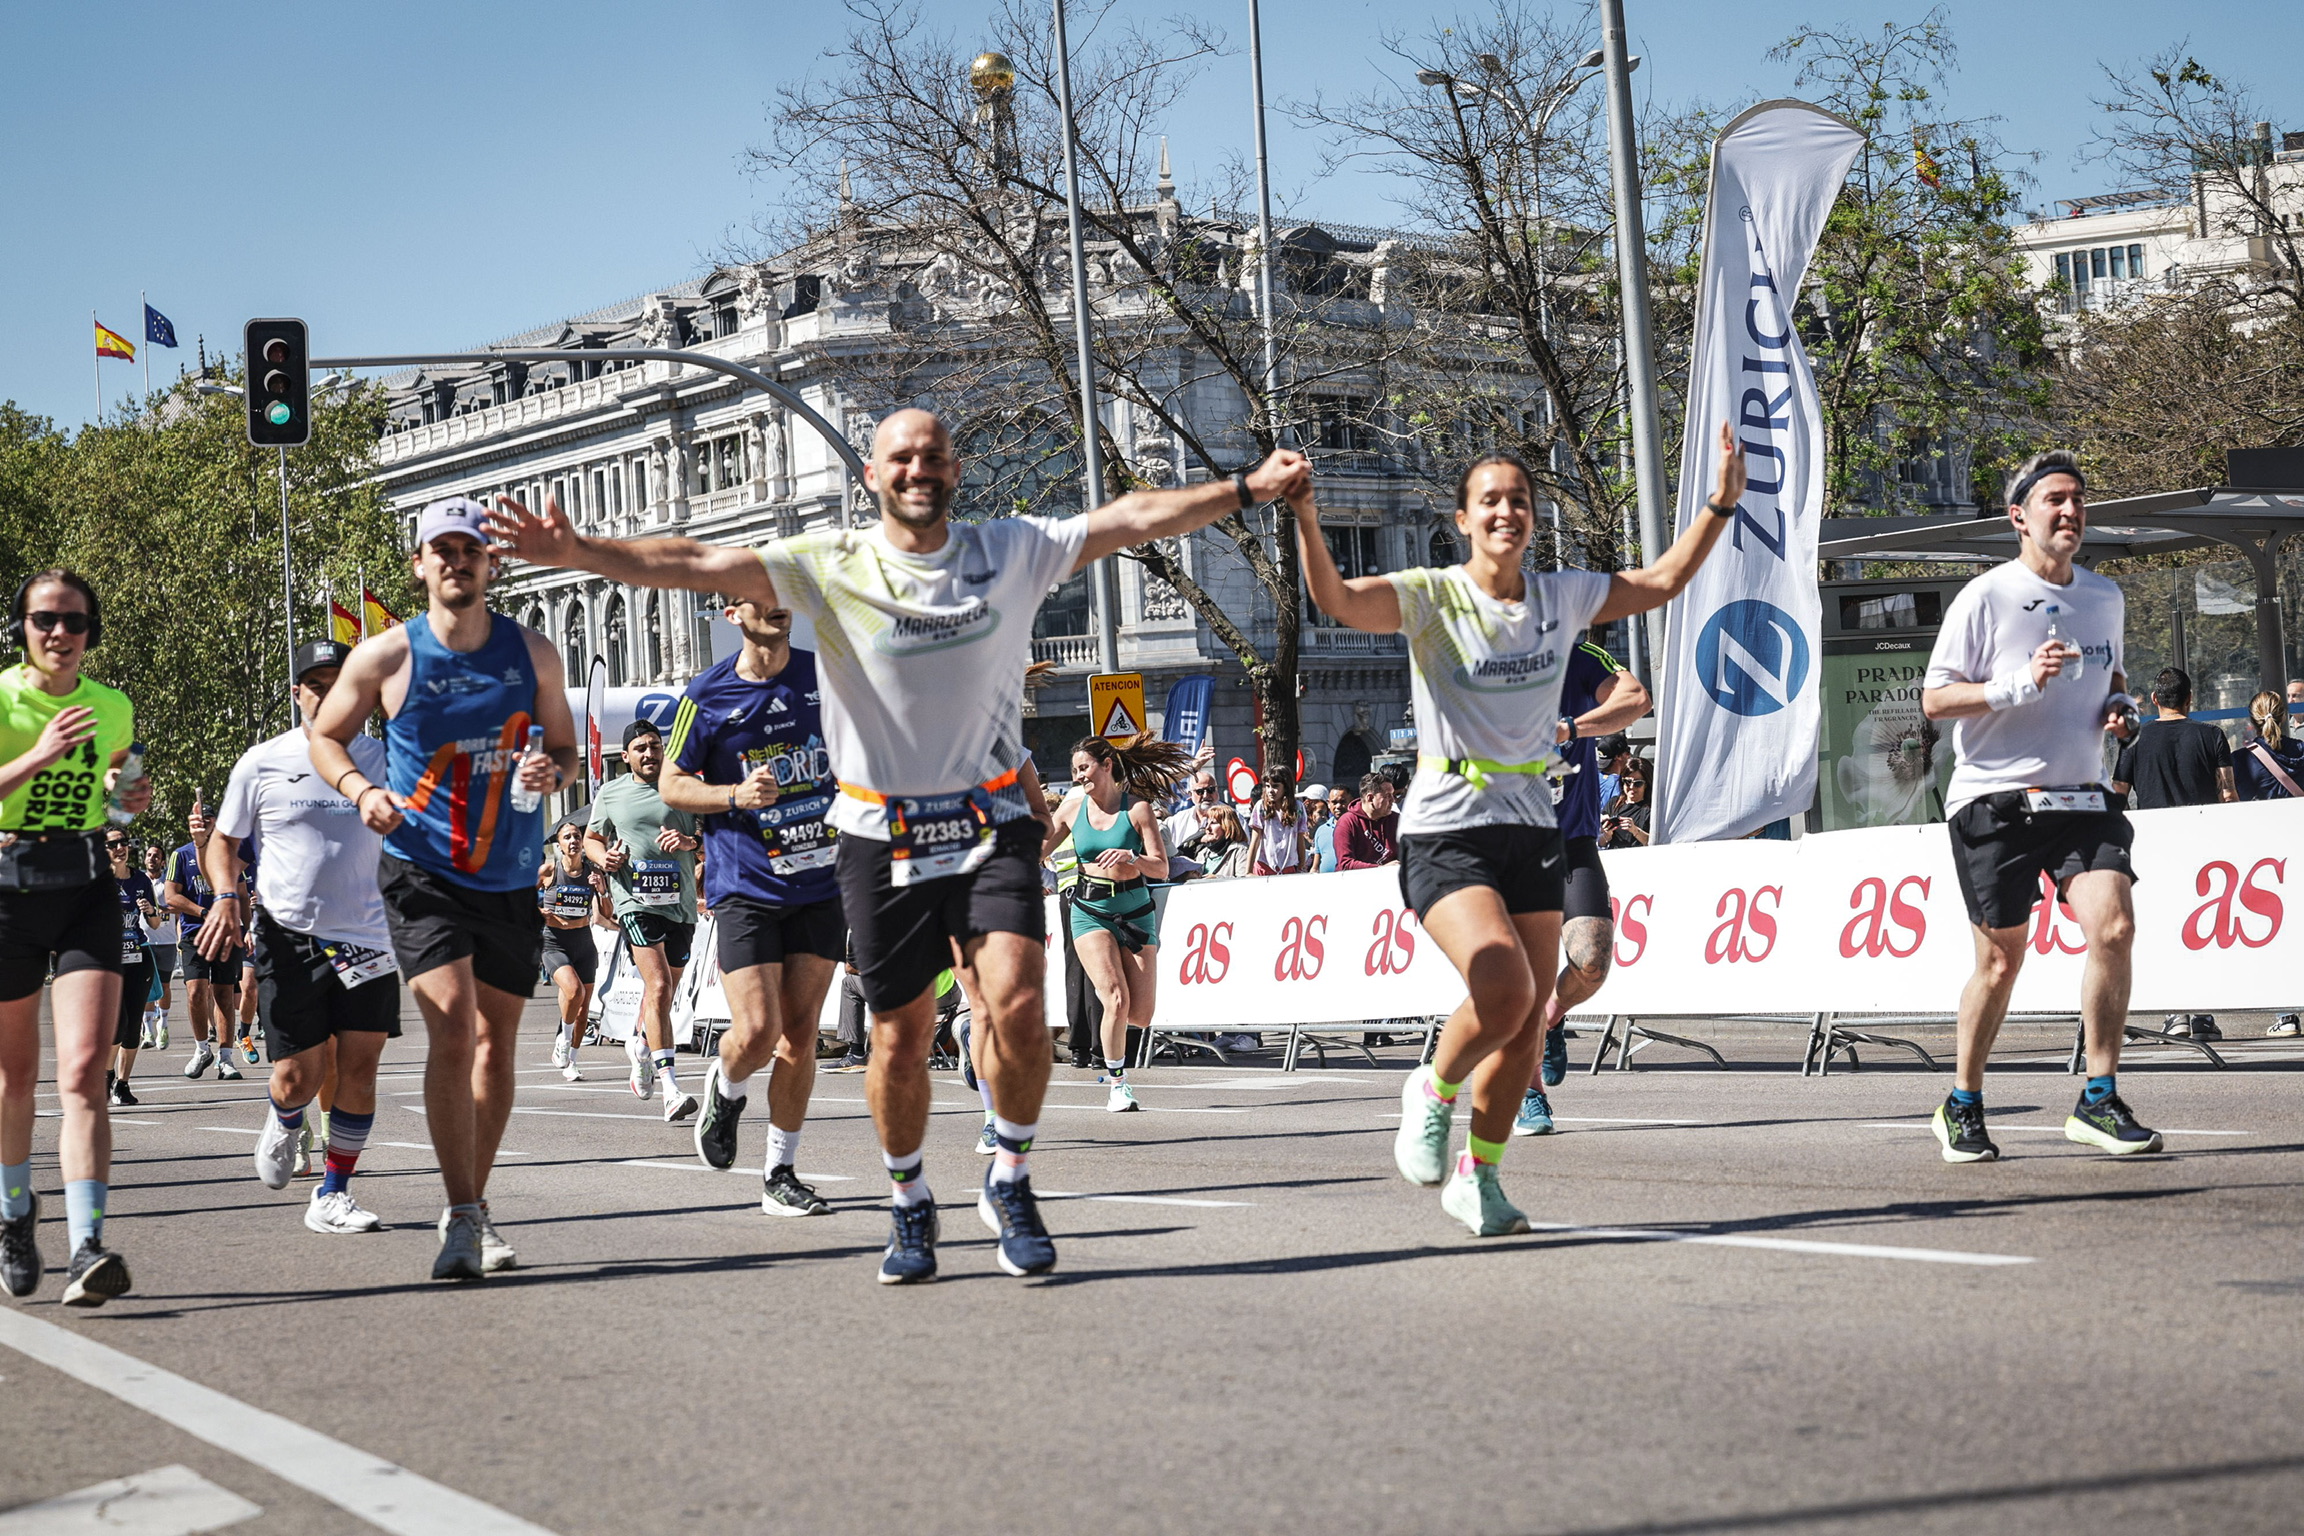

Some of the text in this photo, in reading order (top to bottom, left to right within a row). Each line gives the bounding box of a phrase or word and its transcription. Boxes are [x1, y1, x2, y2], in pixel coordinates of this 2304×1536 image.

[316, 646, 334, 656] MIA
[1875, 642, 1911, 651] JCDecaux
[1472, 649, 1555, 677] MARAZUELA
[1857, 665, 1926, 684] PRADA
[1094, 680, 1140, 692] ATENCION
[1845, 687, 1925, 705] PARADO
[774, 721, 795, 731] ZURICH
[1874, 715, 1918, 723] FRAGRANCES
[748, 743, 785, 762] SIENTE
[472, 750, 514, 776] FAST
[48, 771, 74, 816] CON
[290, 800, 339, 809] HYUNDAI
[785, 801, 820, 817] ZURICH
[924, 797, 964, 813] ZURIC
[779, 821, 824, 846] 34492
[912, 818, 975, 845] 22383
[641, 875, 669, 887] 21831
[563, 895, 584, 904] 34292
[1179, 921, 1234, 986] as
[1274, 914, 1328, 982] as
[1364, 908, 1419, 977] as
[1704, 885, 1783, 965] as
[1838, 875, 1932, 959] as
[2181, 857, 2288, 951] as
[123, 941, 134, 949] 255
